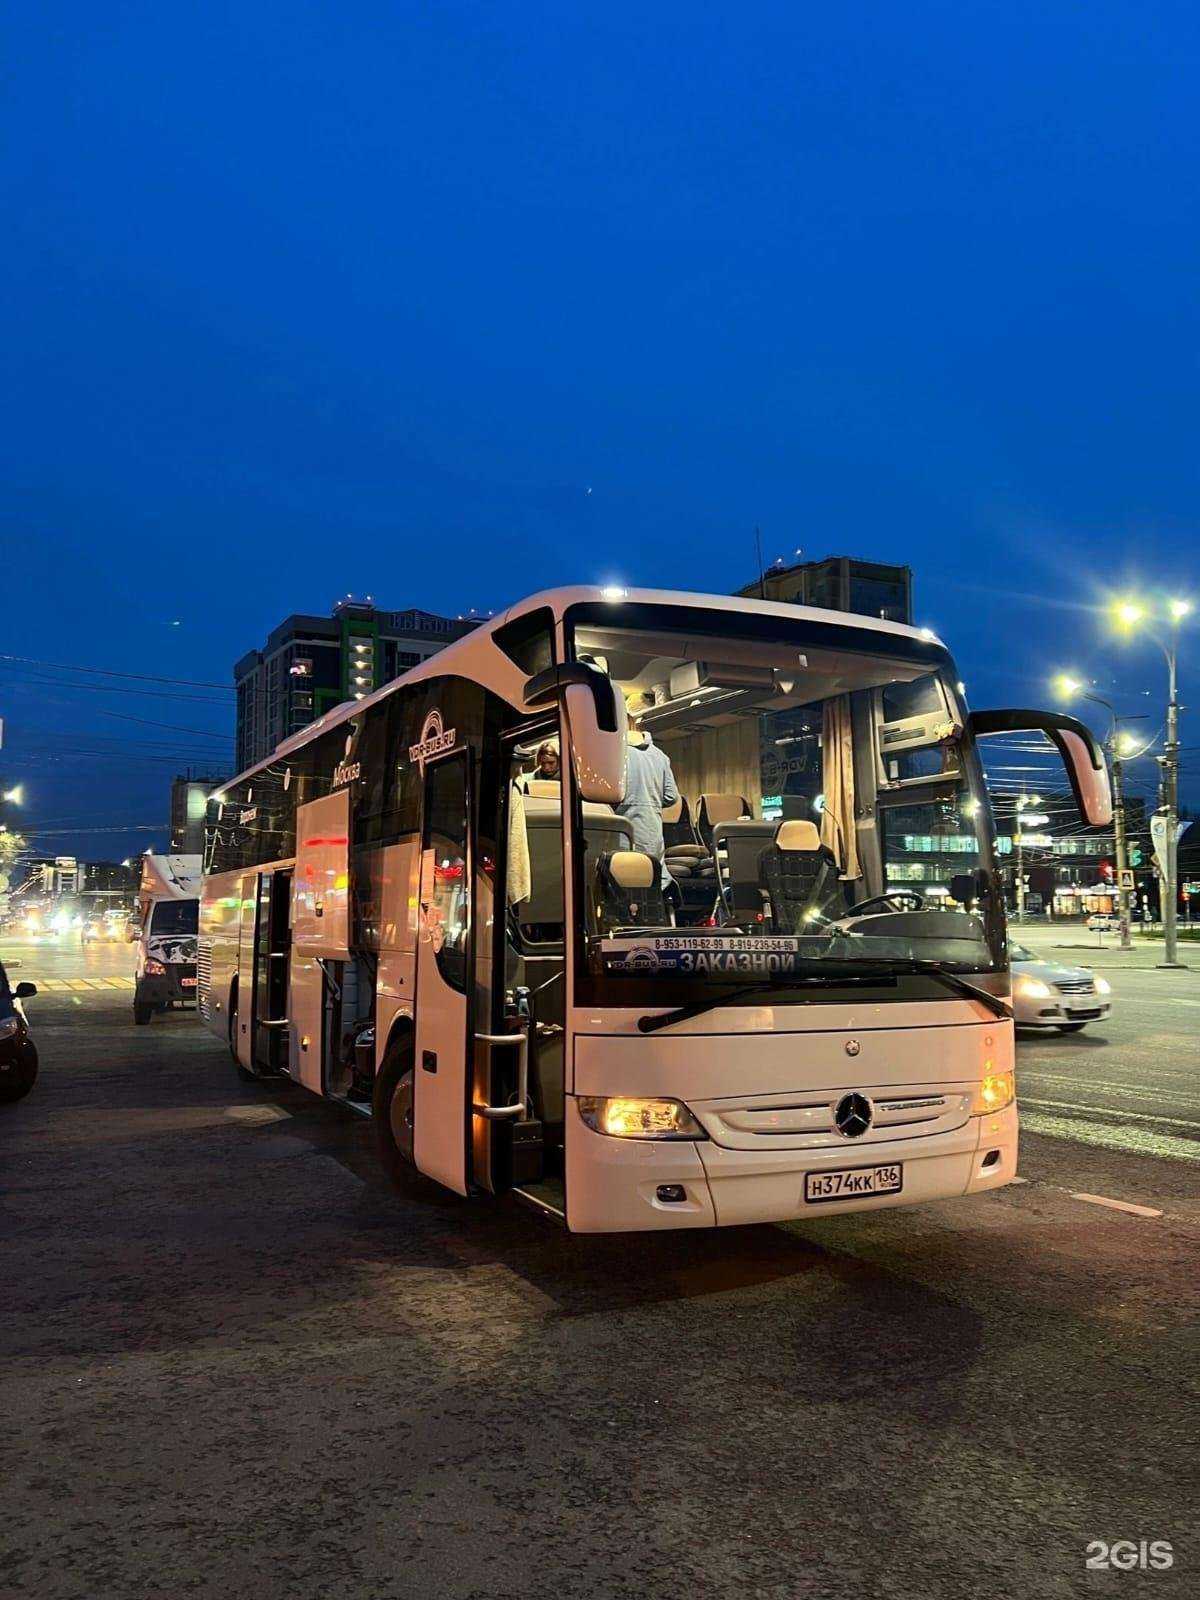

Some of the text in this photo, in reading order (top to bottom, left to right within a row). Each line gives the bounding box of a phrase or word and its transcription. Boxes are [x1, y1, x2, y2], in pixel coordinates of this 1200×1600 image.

[655, 939, 723, 949] 8-953-119-62-99
[680, 952, 795, 973] ЗАКАЗНОЙ
[812, 1167, 898, 1196] Н374КК 136
